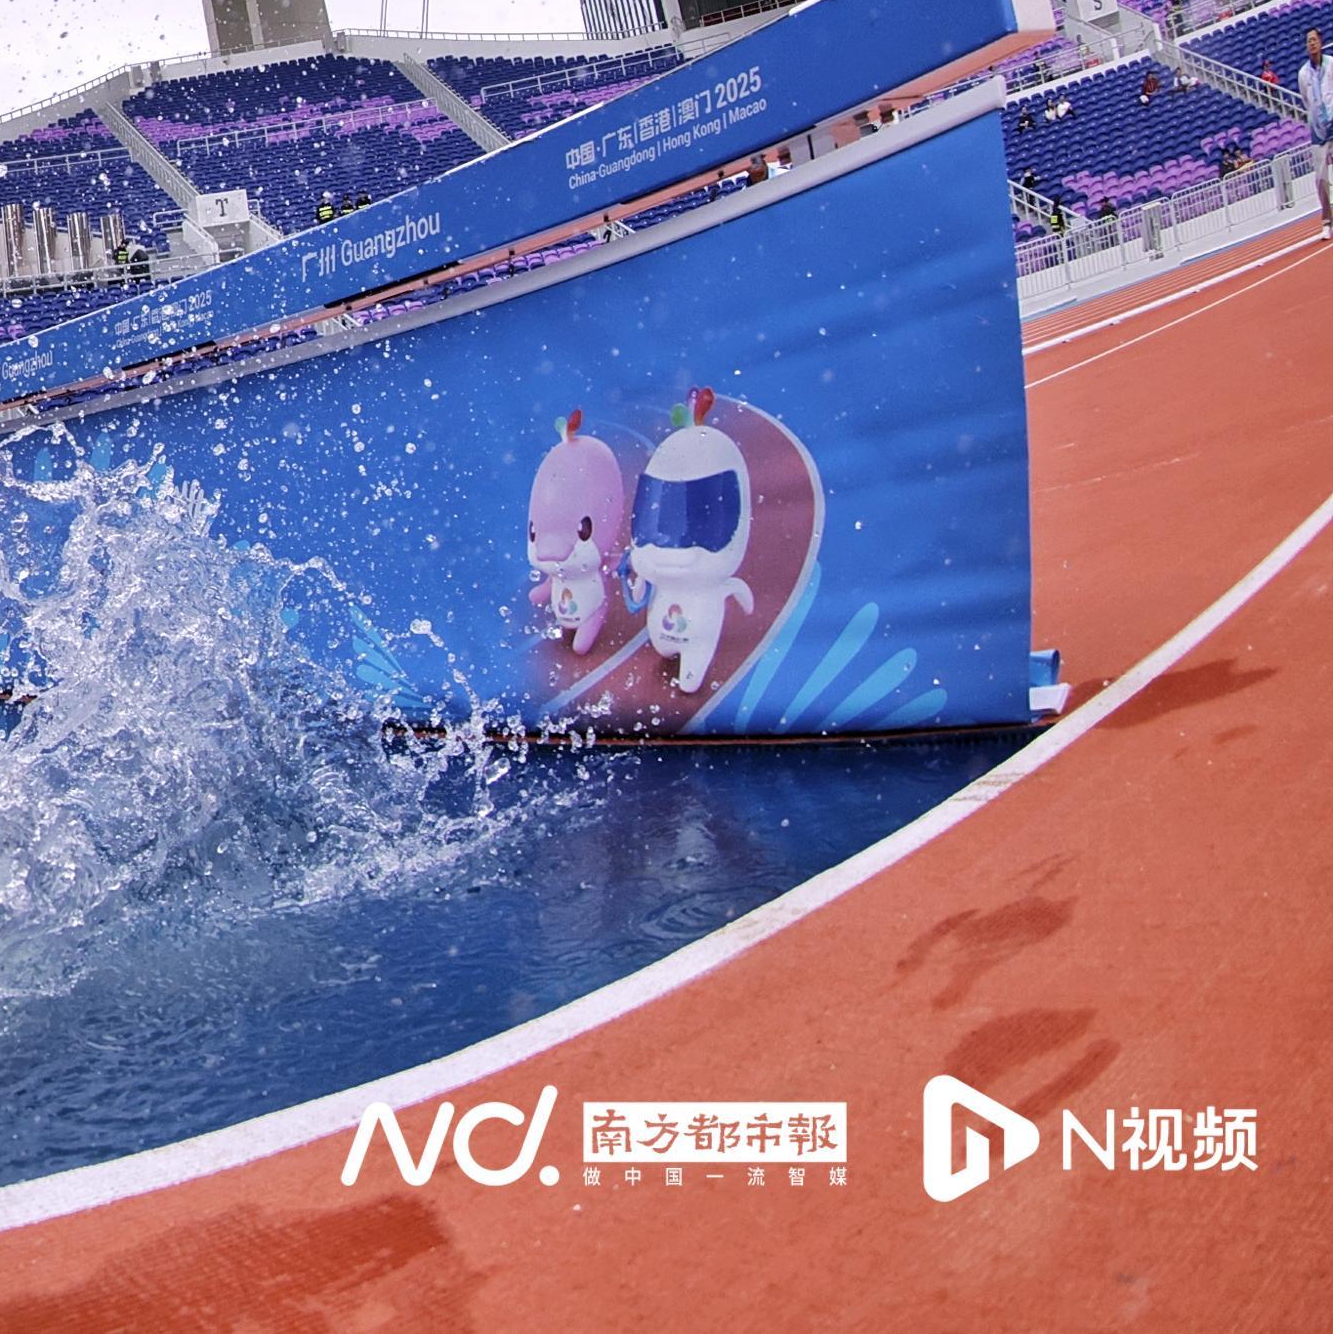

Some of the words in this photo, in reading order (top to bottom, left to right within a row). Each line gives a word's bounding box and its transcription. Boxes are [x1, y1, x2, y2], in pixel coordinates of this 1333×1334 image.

[715, 66, 762, 109] 2025
[663, 132, 691, 153] Hong
[693, 121, 721, 141] Kong
[729, 98, 767, 125] Macao
[215, 198, 229, 217] T
[302, 244, 336, 282] 广州
[341, 212, 441, 267] Guangzhou
[188, 289, 213, 312] 2025
[1, 350, 54, 380] Guangzhou
